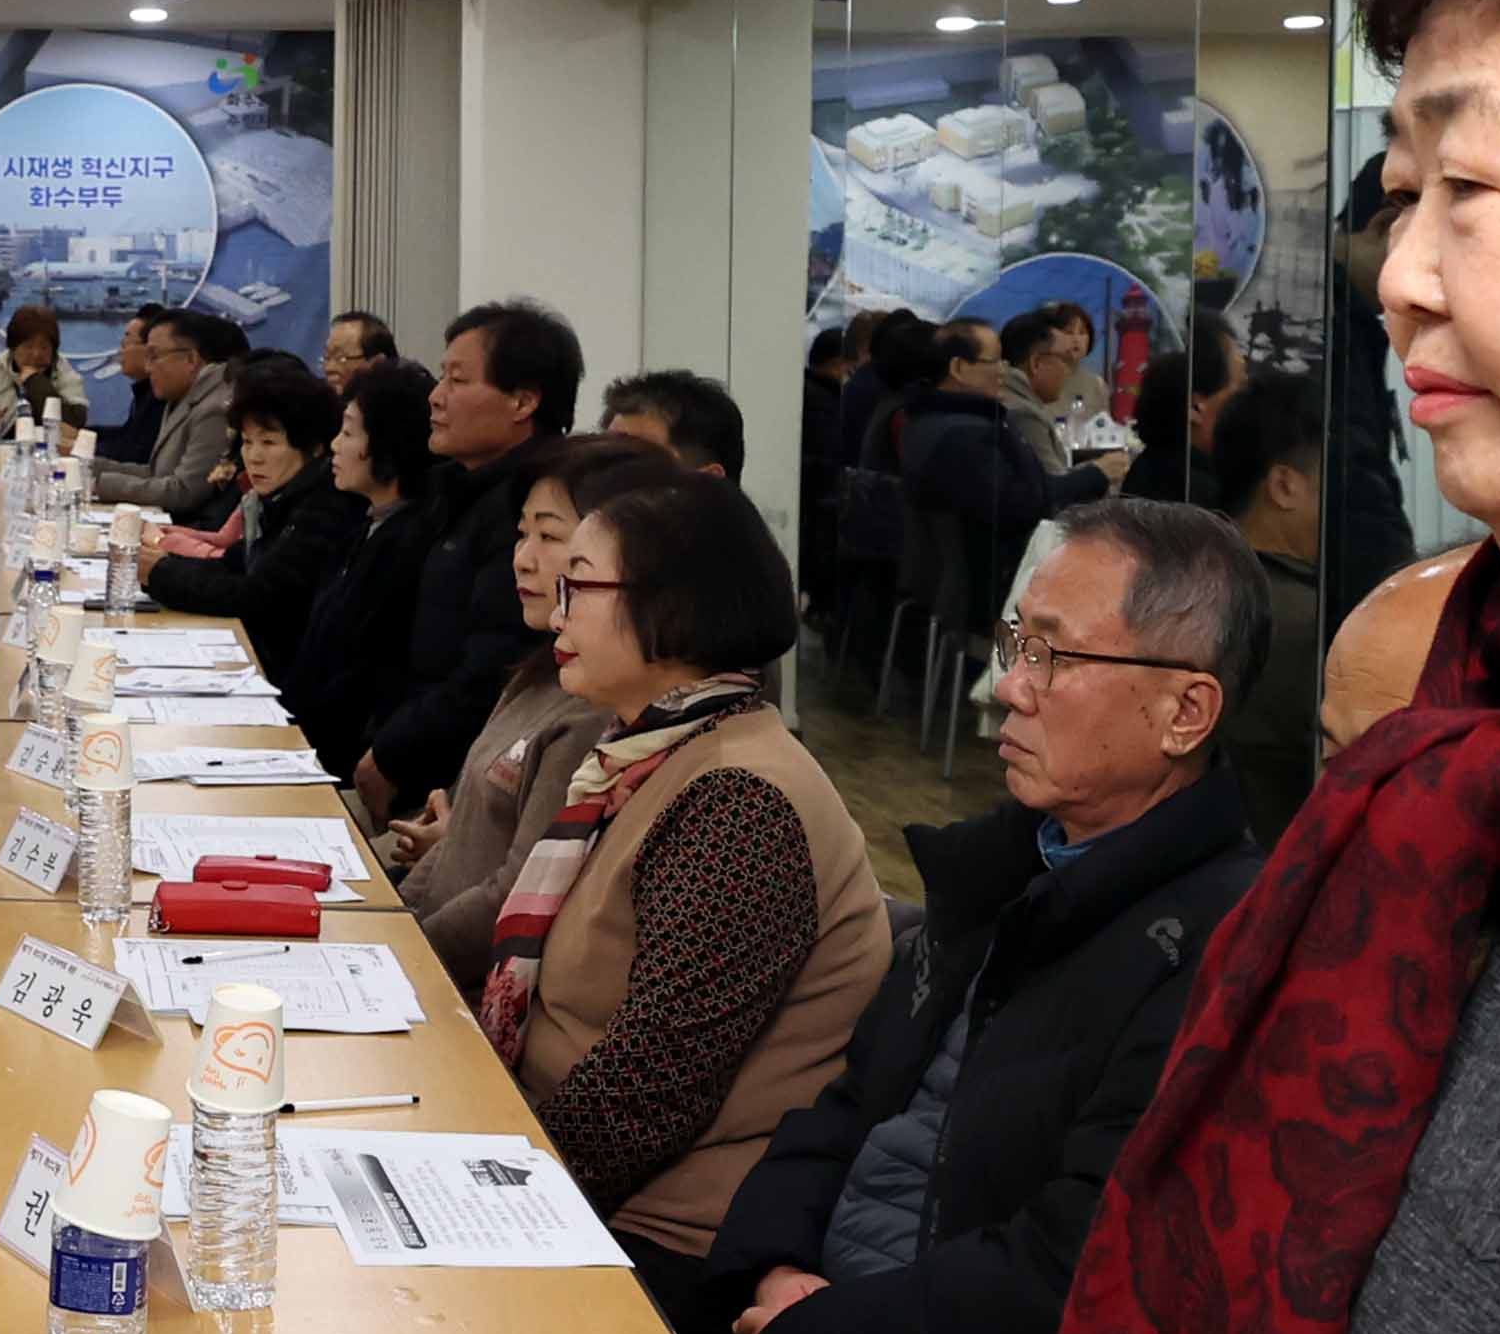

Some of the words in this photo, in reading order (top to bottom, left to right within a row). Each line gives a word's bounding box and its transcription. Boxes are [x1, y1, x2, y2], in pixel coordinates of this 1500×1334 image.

[81, 155, 176, 179] 혁신지구
[28, 185, 124, 209] 화수부두
[12, 970, 94, 1034] 김광욱
